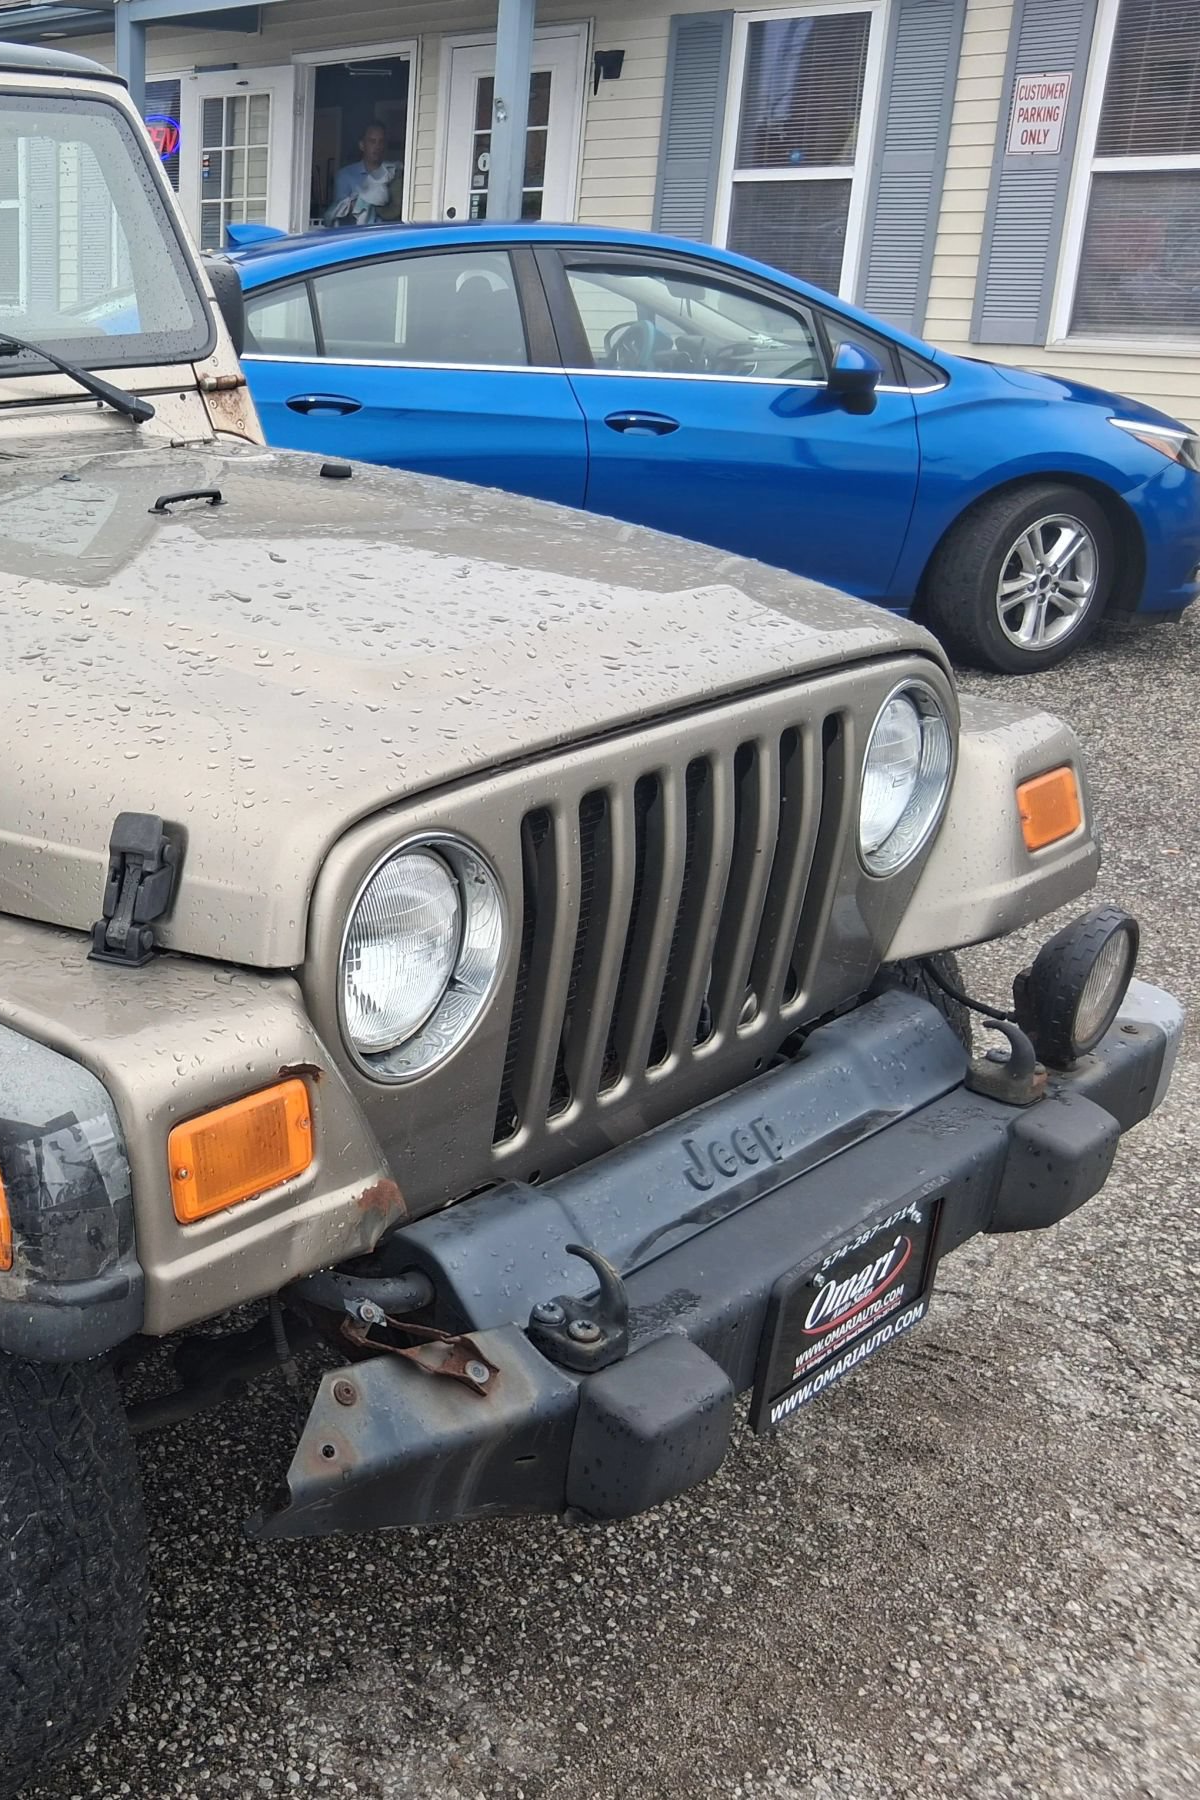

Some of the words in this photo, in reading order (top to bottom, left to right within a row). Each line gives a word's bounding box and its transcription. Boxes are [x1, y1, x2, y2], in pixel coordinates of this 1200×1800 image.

[1017, 106, 1060, 123] PARKING
[1019, 83, 1066, 101] CUSTOMER
[1020, 129, 1050, 145] ONLY
[681, 1115, 784, 1191] Jeep
[821, 1201, 917, 1271] 574-287-4714
[804, 1235, 902, 1329] Omari
[795, 1284, 904, 1367] WWW.OMARIAUTO.COM
[770, 1303, 924, 1423] WWW.OMARIAUTO.COM
